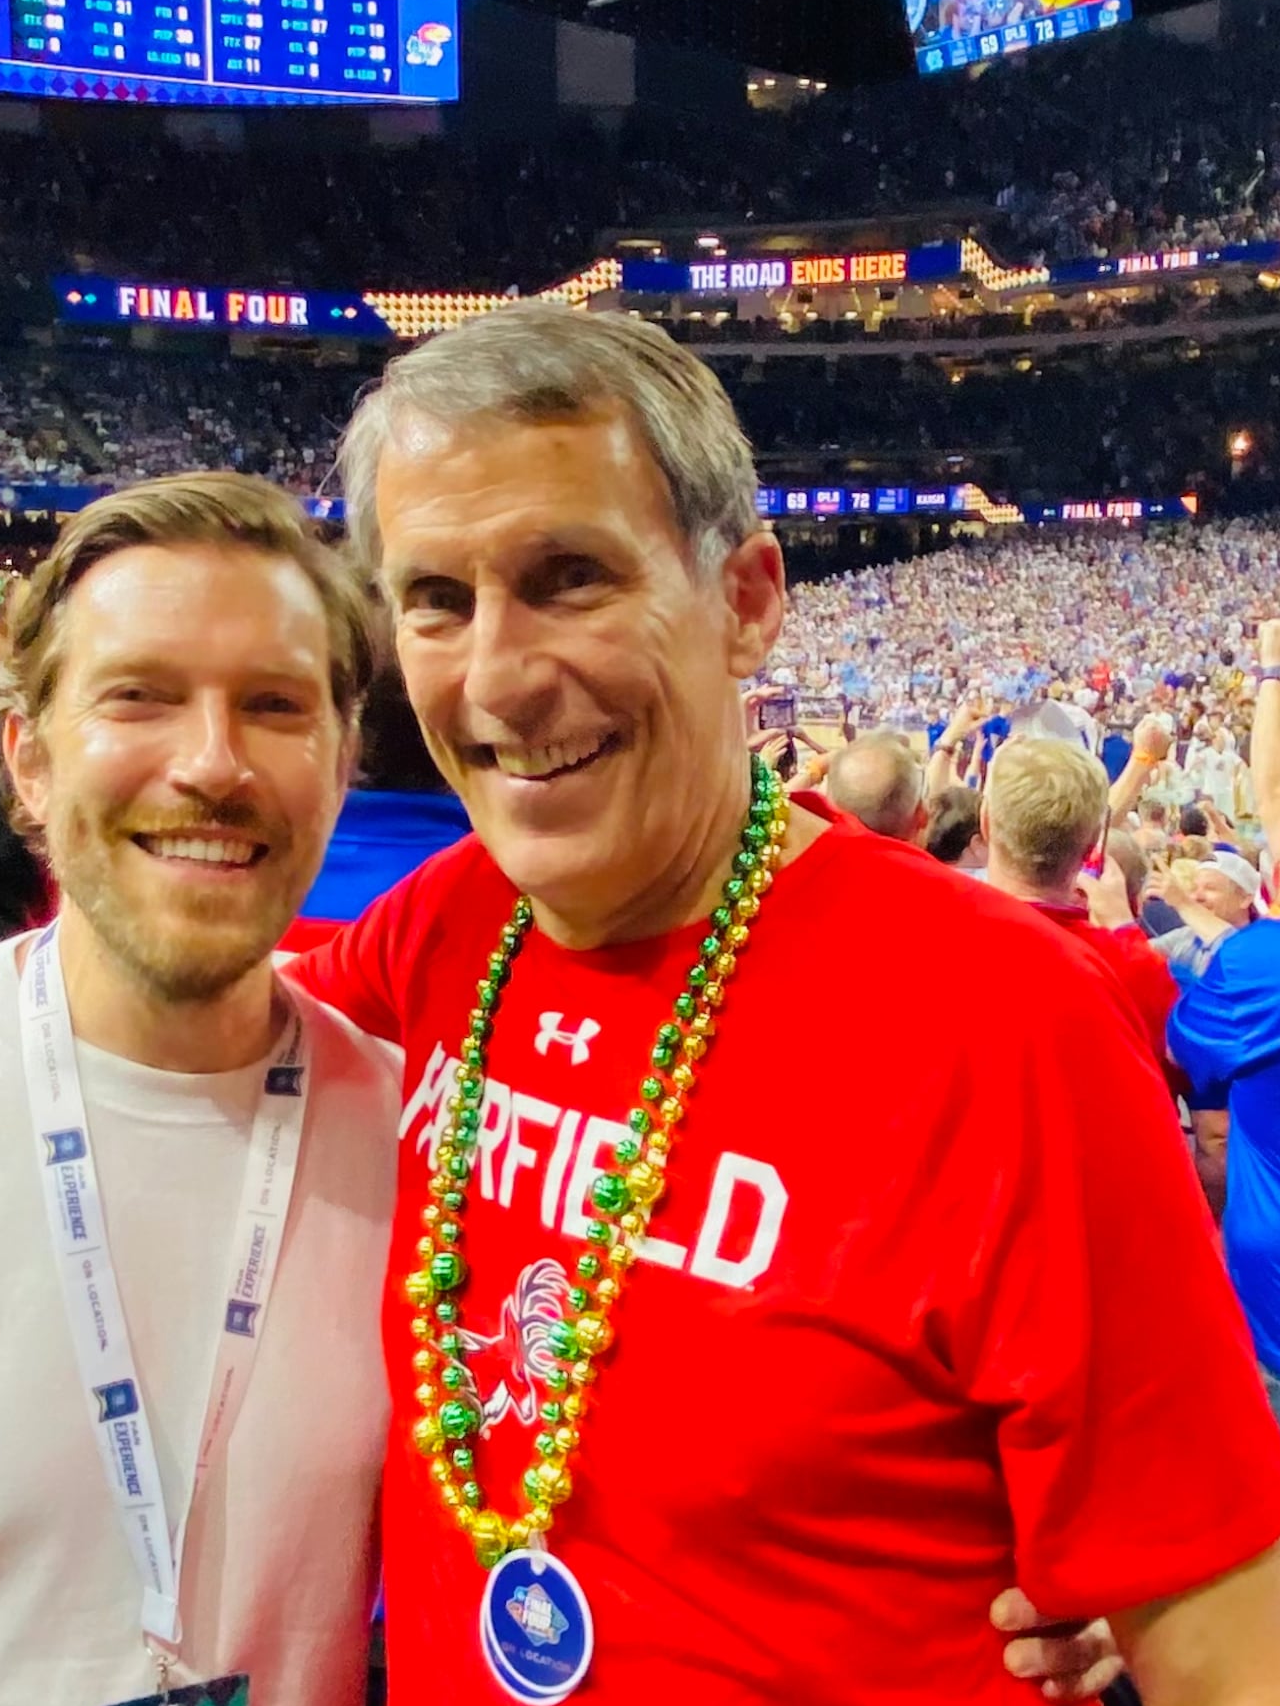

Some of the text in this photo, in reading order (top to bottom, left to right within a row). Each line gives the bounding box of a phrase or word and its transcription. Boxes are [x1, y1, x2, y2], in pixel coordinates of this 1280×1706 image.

[980, 33, 1000, 56] 69
[1034, 18, 1056, 42] 72
[689, 252, 907, 290] THE ROAD ENDS HERE
[1118, 249, 1199, 275] FINAL FOUR
[119, 286, 310, 326] FINAL FOUR
[786, 492, 808, 510] 69
[851, 493, 871, 510] 72
[1062, 501, 1142, 519] FINAL FOUR
[266, 1122, 283, 1178] LOCATION
[60, 1165, 88, 1241] EXPERIENCE
[241, 1224, 268, 1299] EXPERIENCE
[81, 1258, 110, 1353] ON LOCATION
[113, 1421, 143, 1498] EXPERIENCE
[521, 1647, 574, 1675] LOCATION
